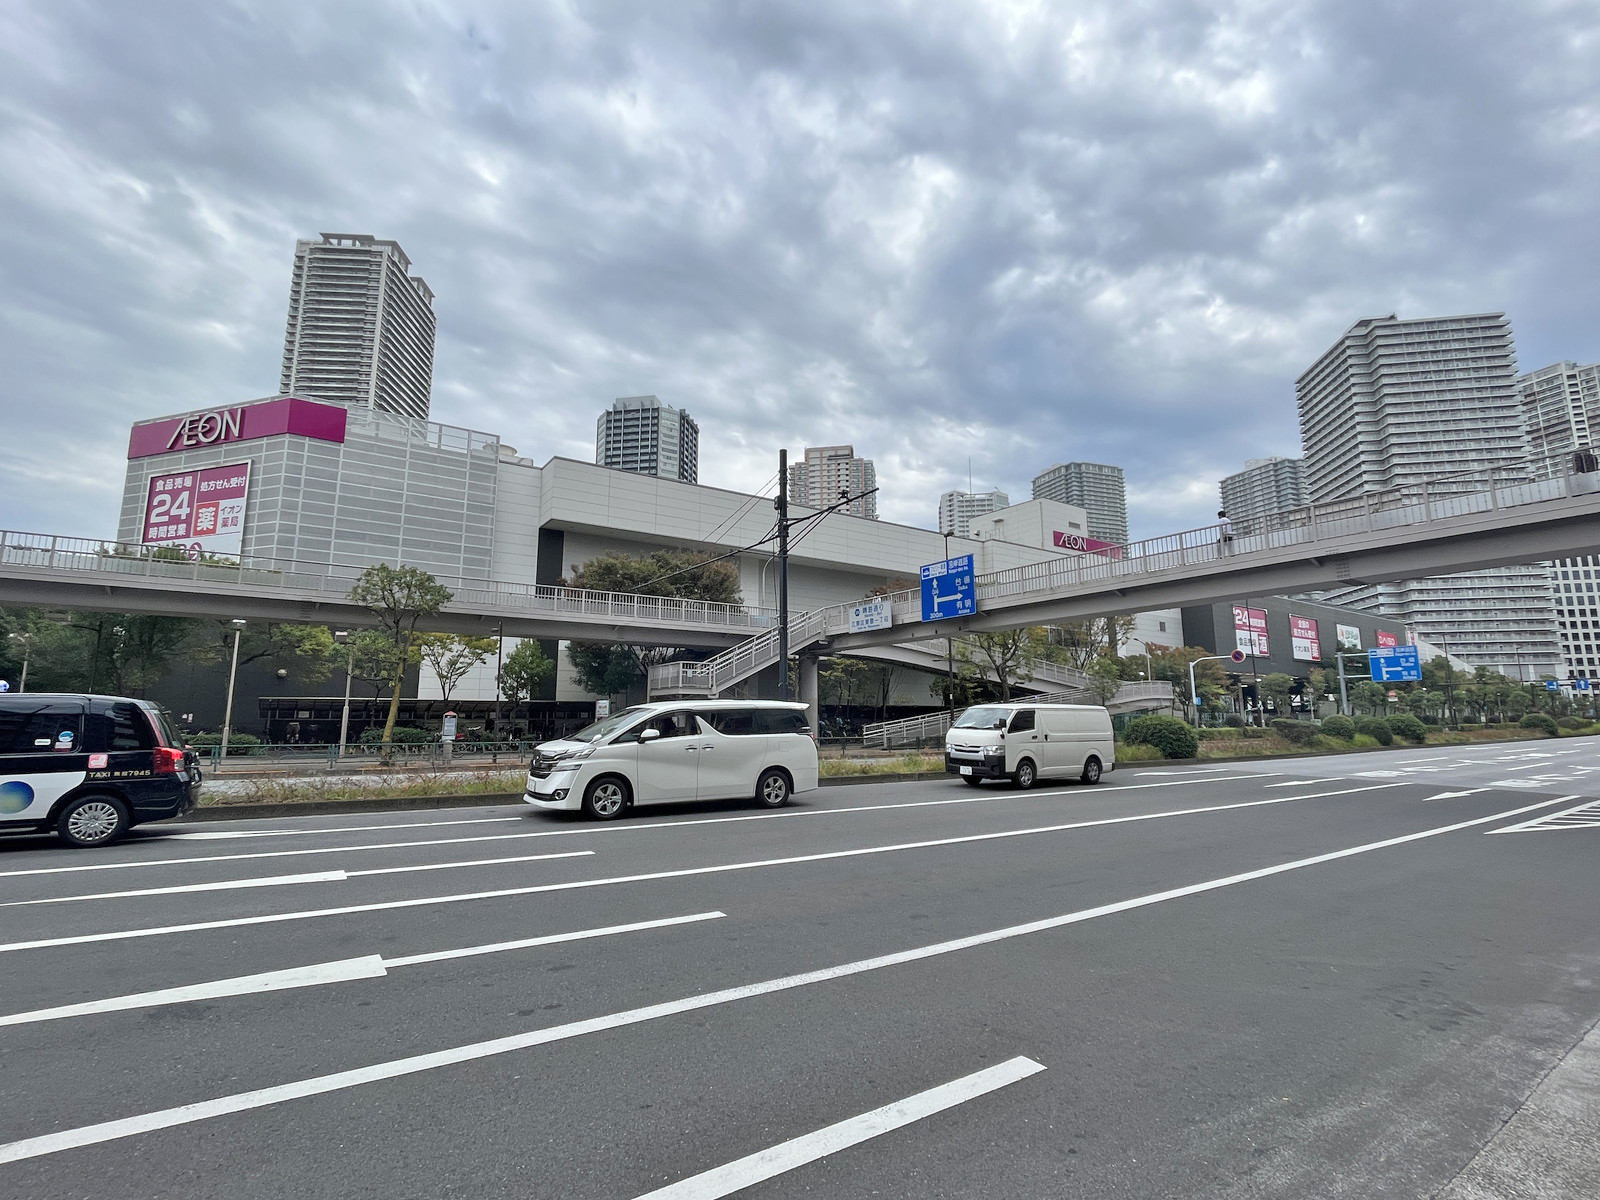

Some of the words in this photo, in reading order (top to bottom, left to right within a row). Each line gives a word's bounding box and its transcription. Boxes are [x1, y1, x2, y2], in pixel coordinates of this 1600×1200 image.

[155, 475, 193, 492] 食品売場
[199, 475, 246, 492] 処方せん受付
[150, 491, 190, 524] 24
[220, 505, 243, 515] イオン
[196, 506, 217, 531] 薬
[220, 516, 239, 528] 薬局
[148, 523, 187, 539] 時間営業
[956, 599, 971, 609] 有明
[1235, 608, 1249, 625] 24
[1378, 635, 1396, 646] DAISO
[1311, 643, 1319, 657] 薬
[113, 769, 151, 777] 7945
